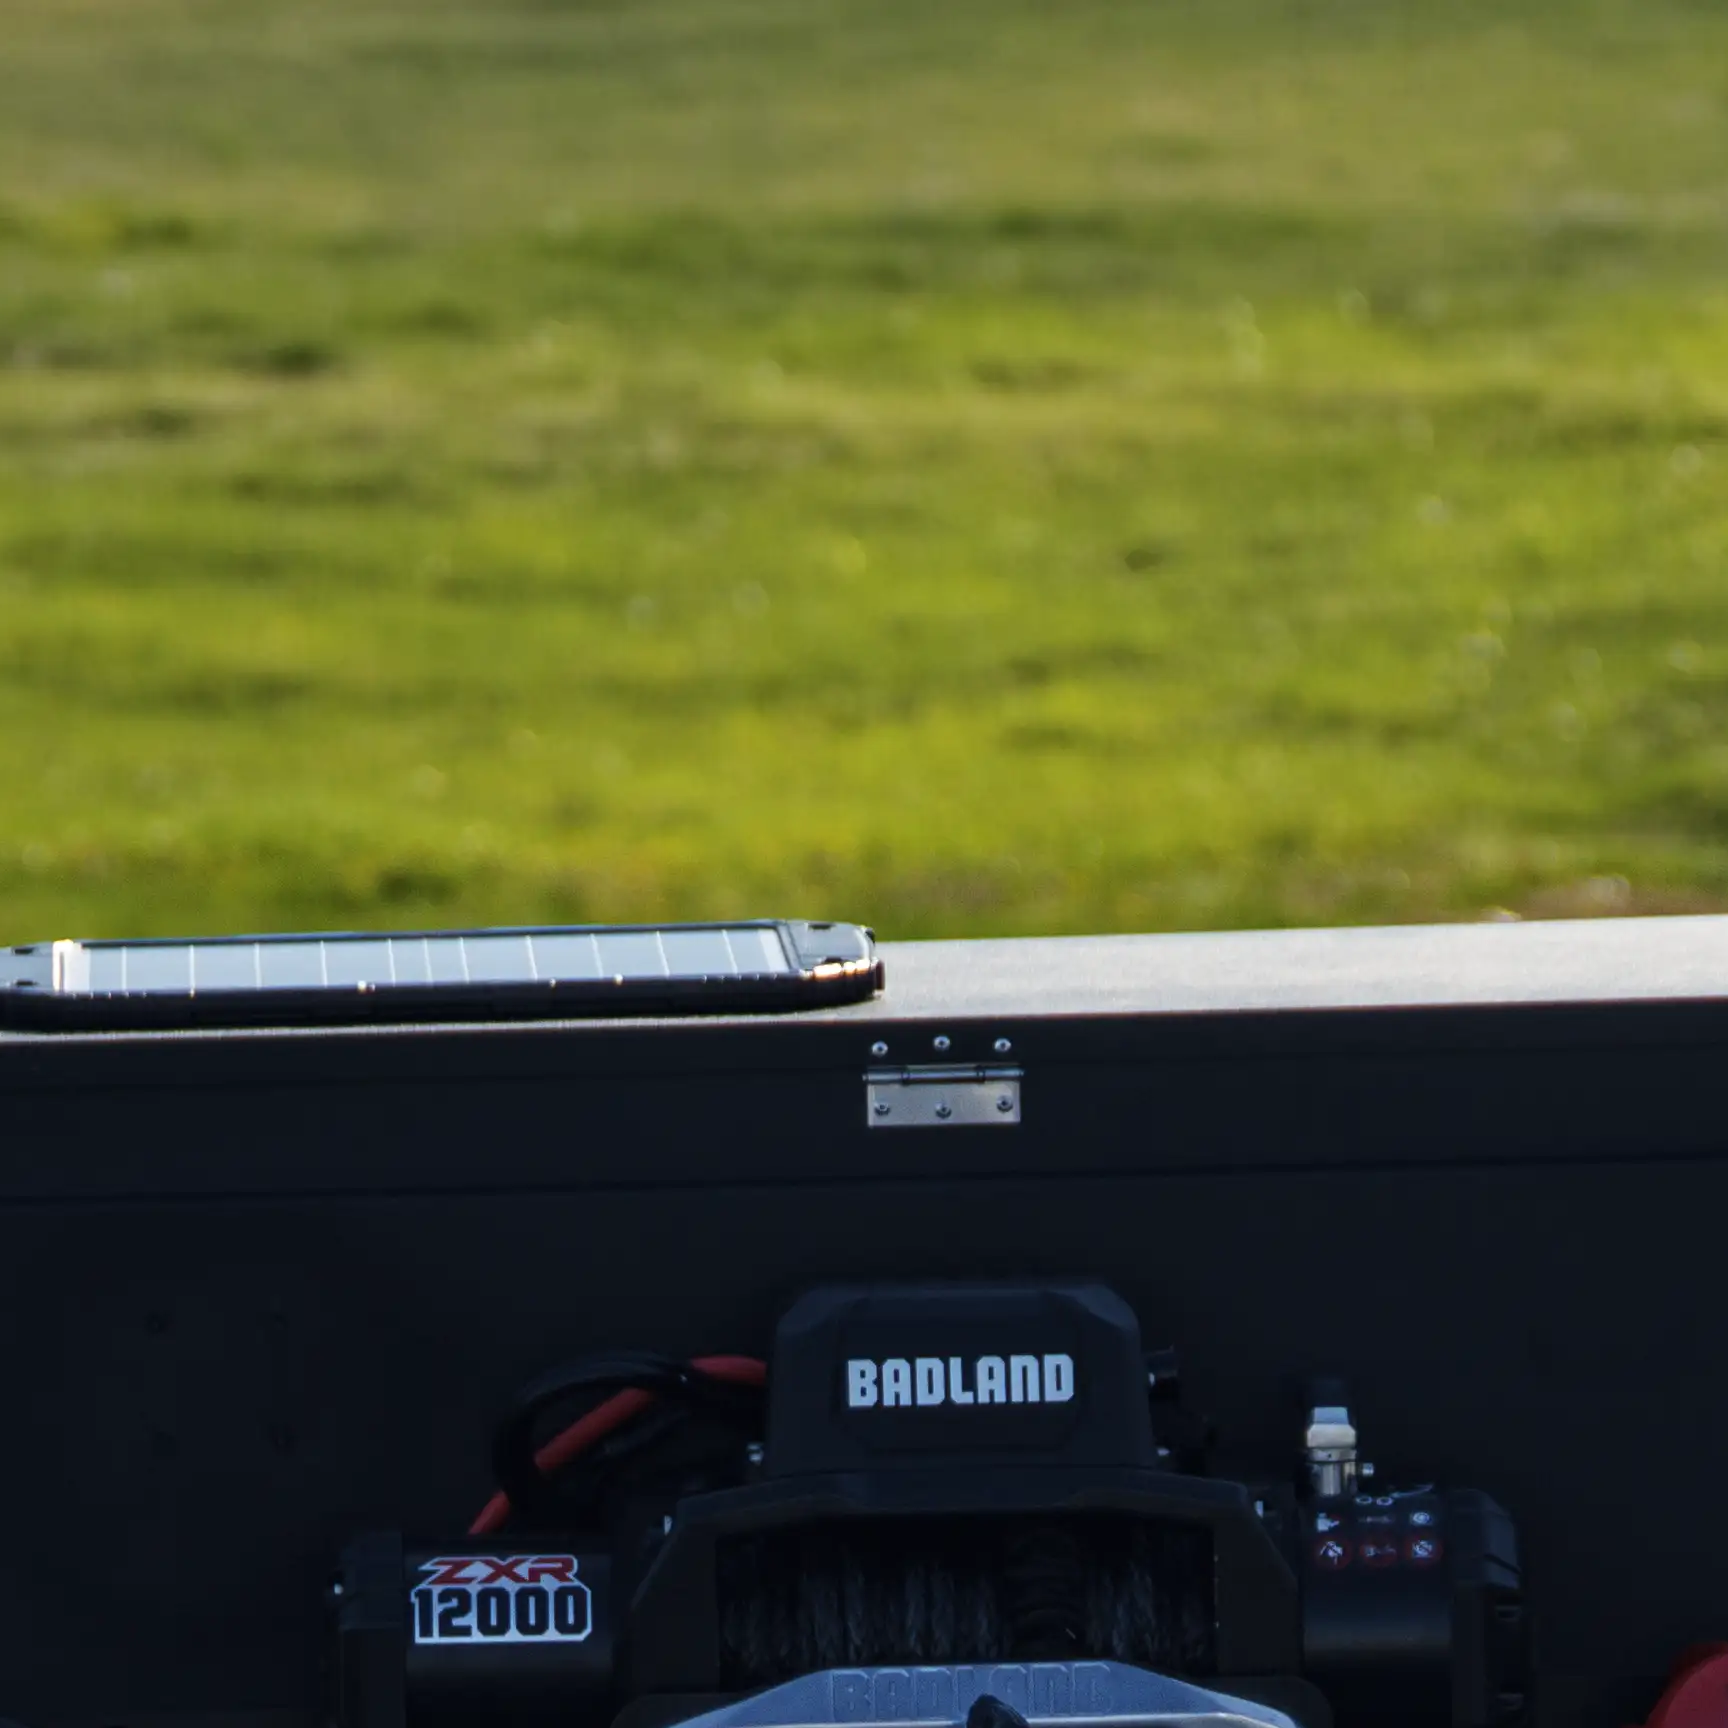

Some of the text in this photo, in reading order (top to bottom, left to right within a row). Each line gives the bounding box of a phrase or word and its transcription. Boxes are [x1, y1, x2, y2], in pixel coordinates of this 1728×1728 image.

[847, 1353, 1075, 1407] BADLAND
[420, 1555, 578, 1586] ZXR
[413, 1586, 589, 1638] 12000
